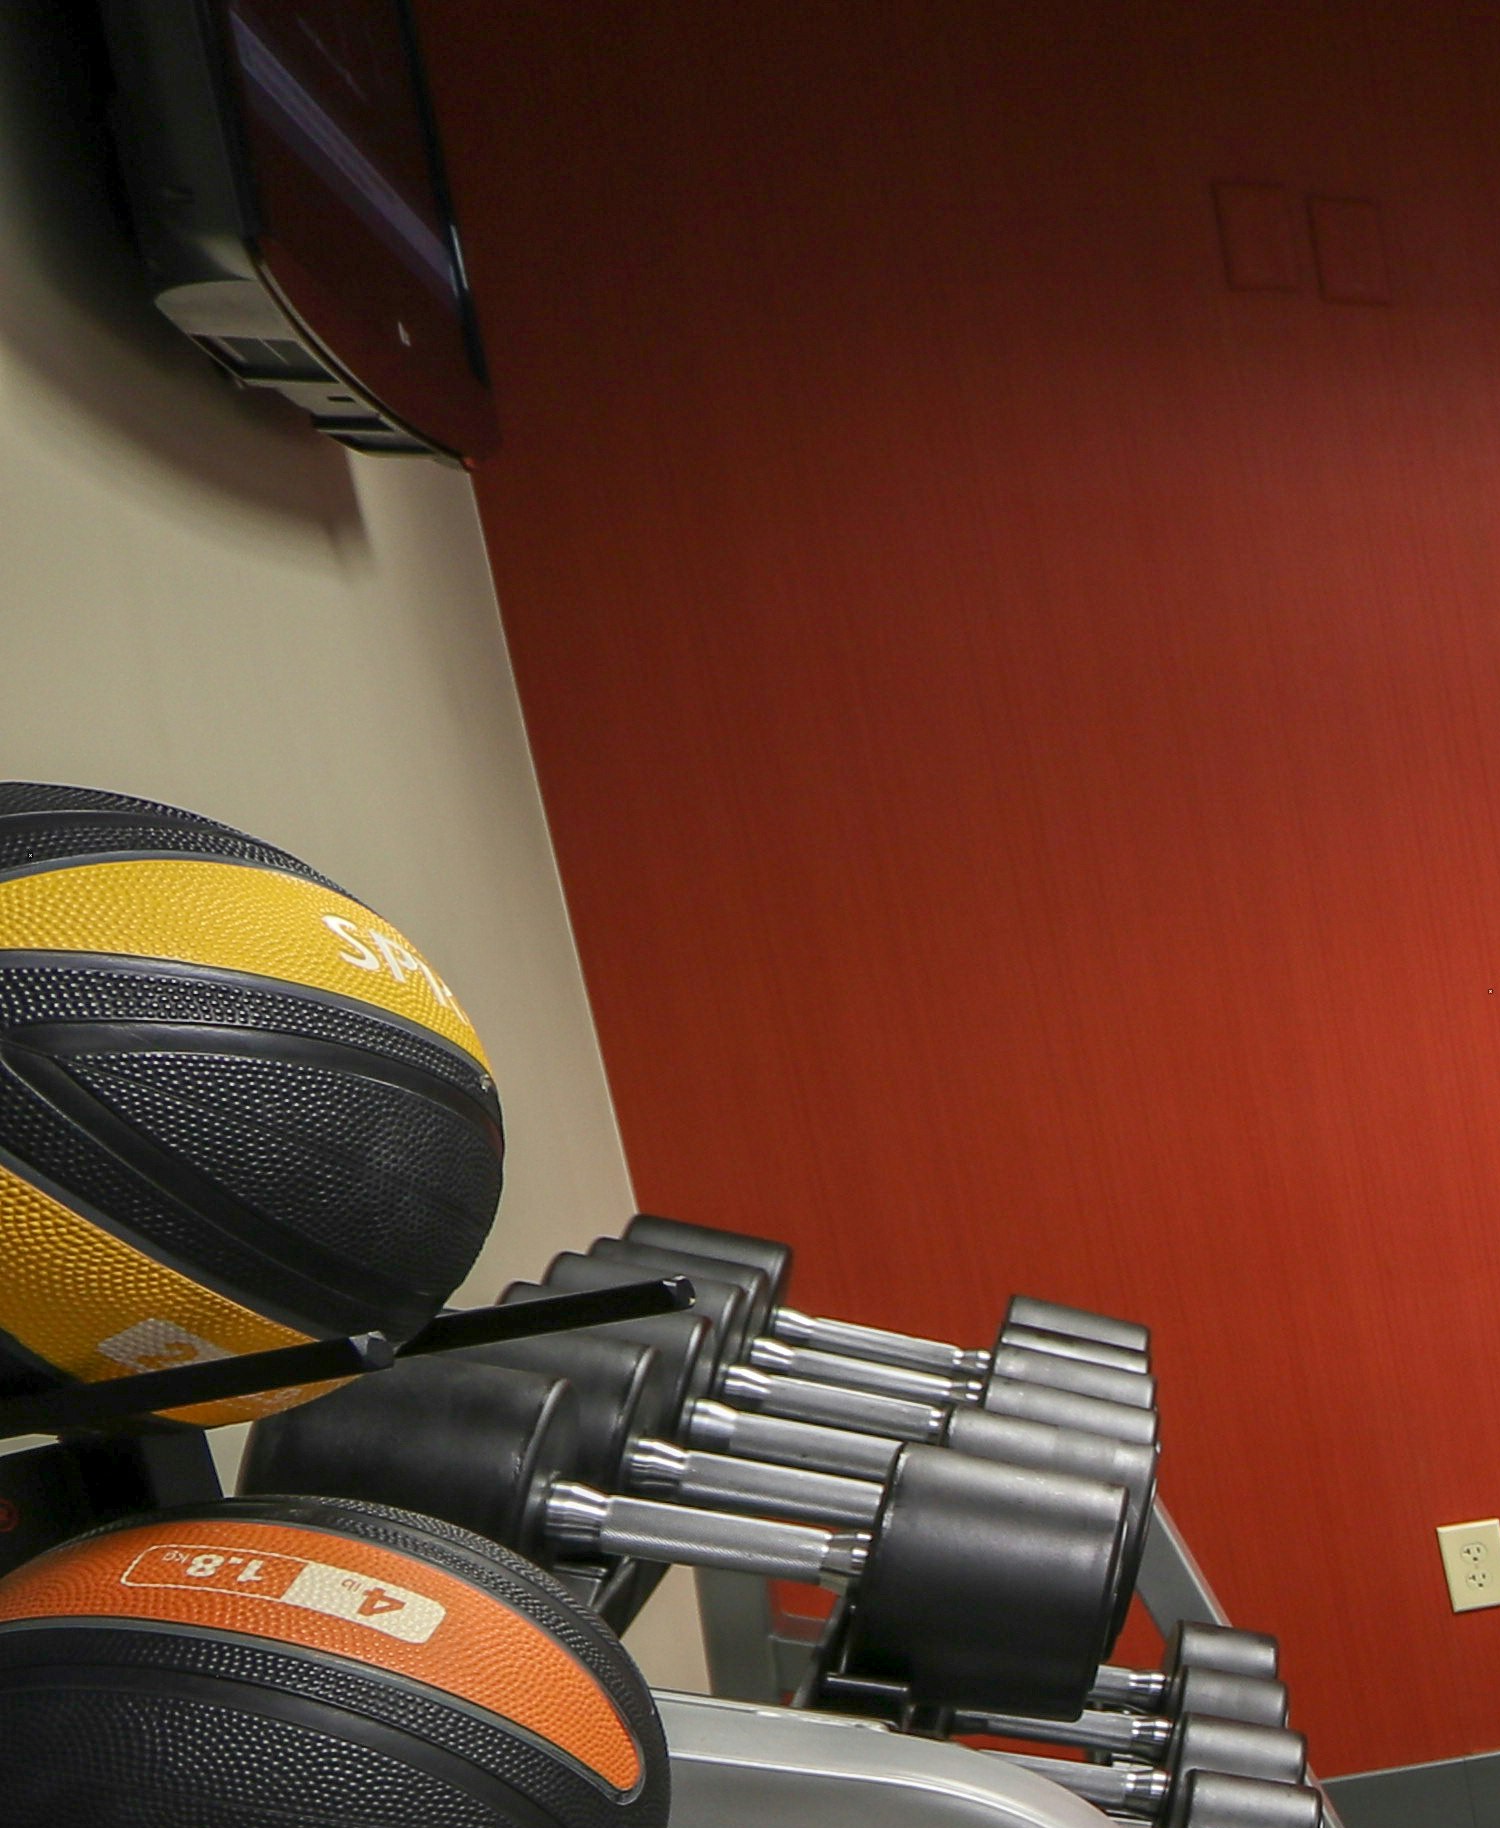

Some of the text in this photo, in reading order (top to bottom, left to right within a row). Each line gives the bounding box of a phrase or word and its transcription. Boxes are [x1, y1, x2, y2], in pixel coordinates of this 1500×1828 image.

[321, 914, 471, 1027] SPR
[185, 1553, 265, 1583] 1.8
[356, 1586, 406, 1618] 4
